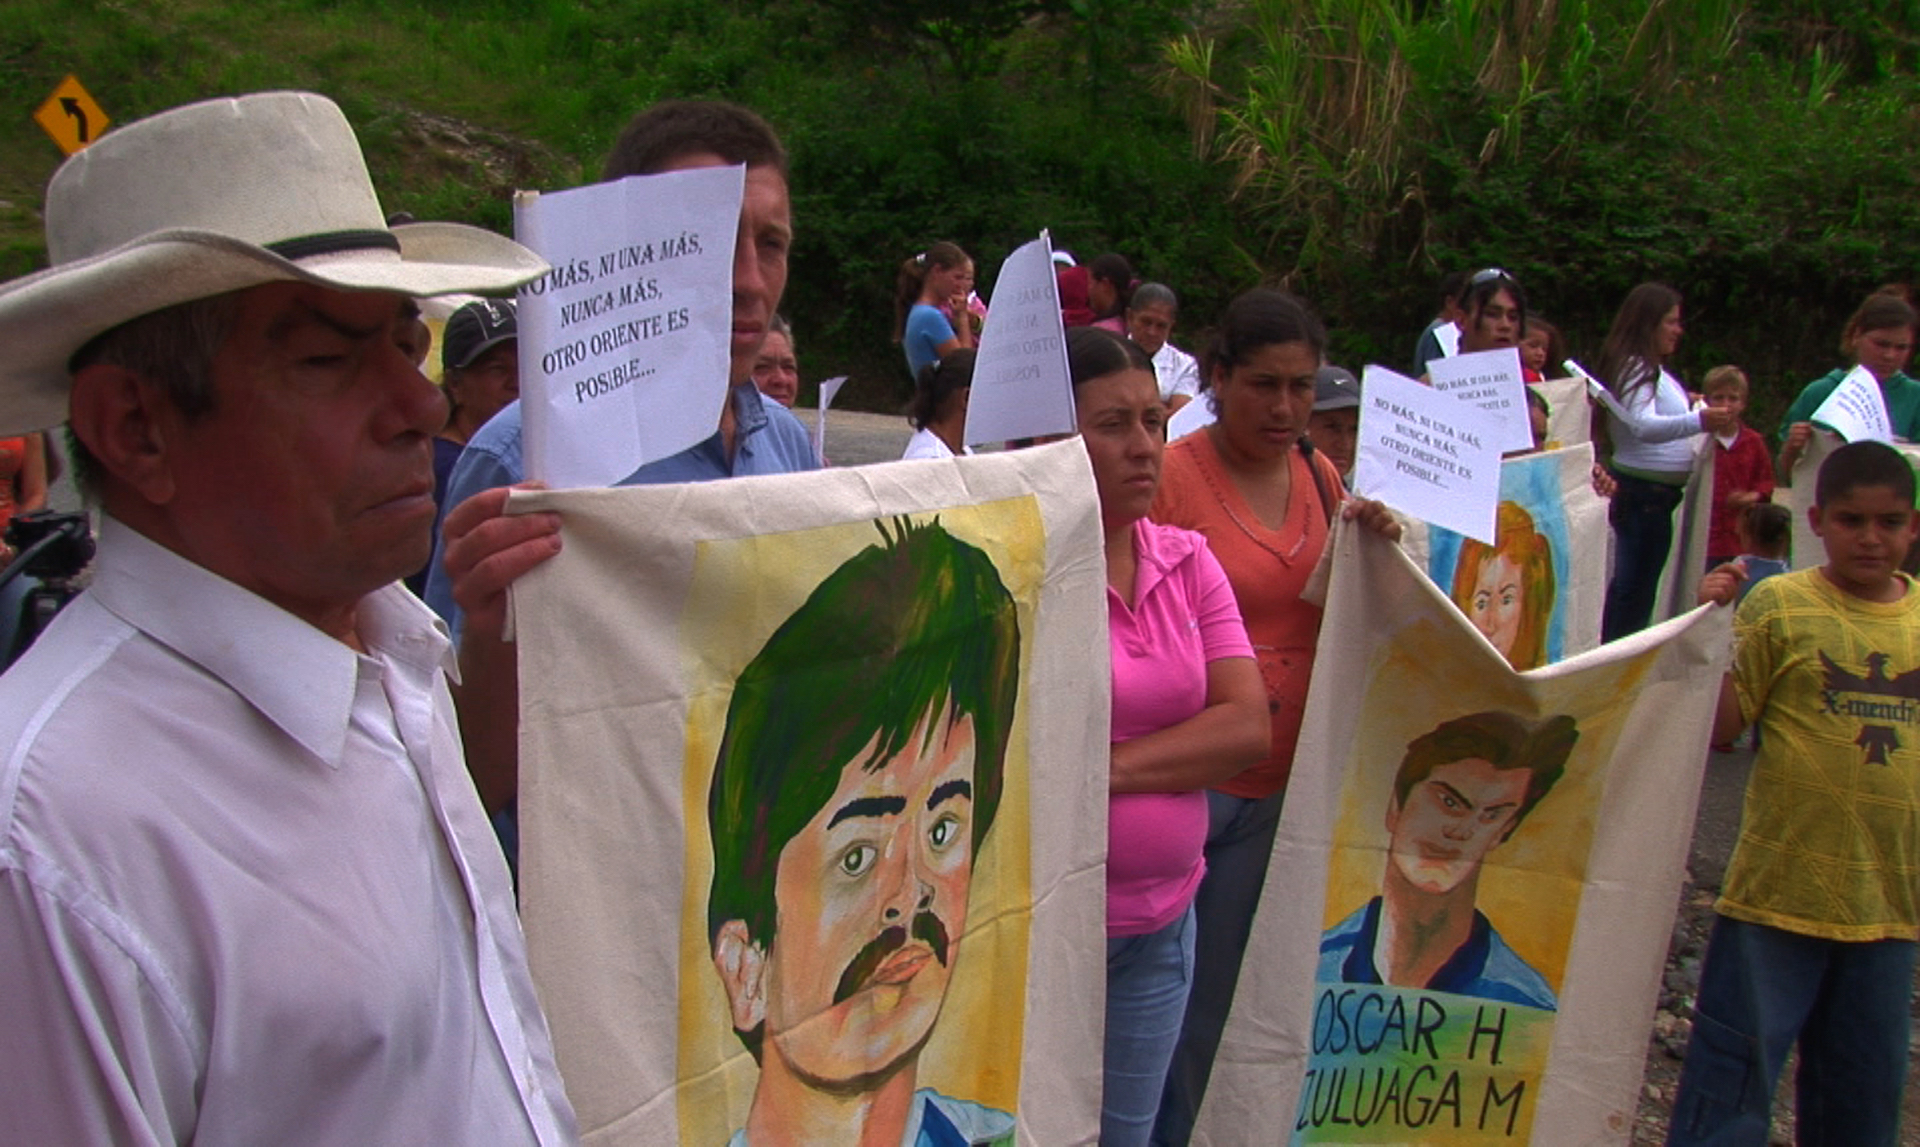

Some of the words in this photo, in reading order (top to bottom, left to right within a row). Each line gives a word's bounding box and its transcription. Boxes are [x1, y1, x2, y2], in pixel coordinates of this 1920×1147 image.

[549, 257, 594, 292] MÁS,
[598, 254, 616, 280] NI
[618, 243, 655, 271] UNA
[658, 231, 703, 263] MÁS,
[561, 291, 614, 328] NUNCA
[618, 278, 662, 309] MÁS,
[542, 339, 587, 375] OTRO
[589, 314, 662, 356] ORIENTE
[667, 308, 690, 332] ES
[575, 357, 656, 404] POSIBLE...
[1374, 397, 1389, 411] NO
[1391, 403, 1417, 424] MÁS,
[1395, 423, 1431, 447] NUNCA
[1381, 436, 1410, 455] OTRO
[1411, 446, 1456, 475] ORIENTE
[1458, 464, 1473, 480] ES
[1312, 988, 1447, 1061] OSCAR
[1477, 1075, 1526, 1137] M
